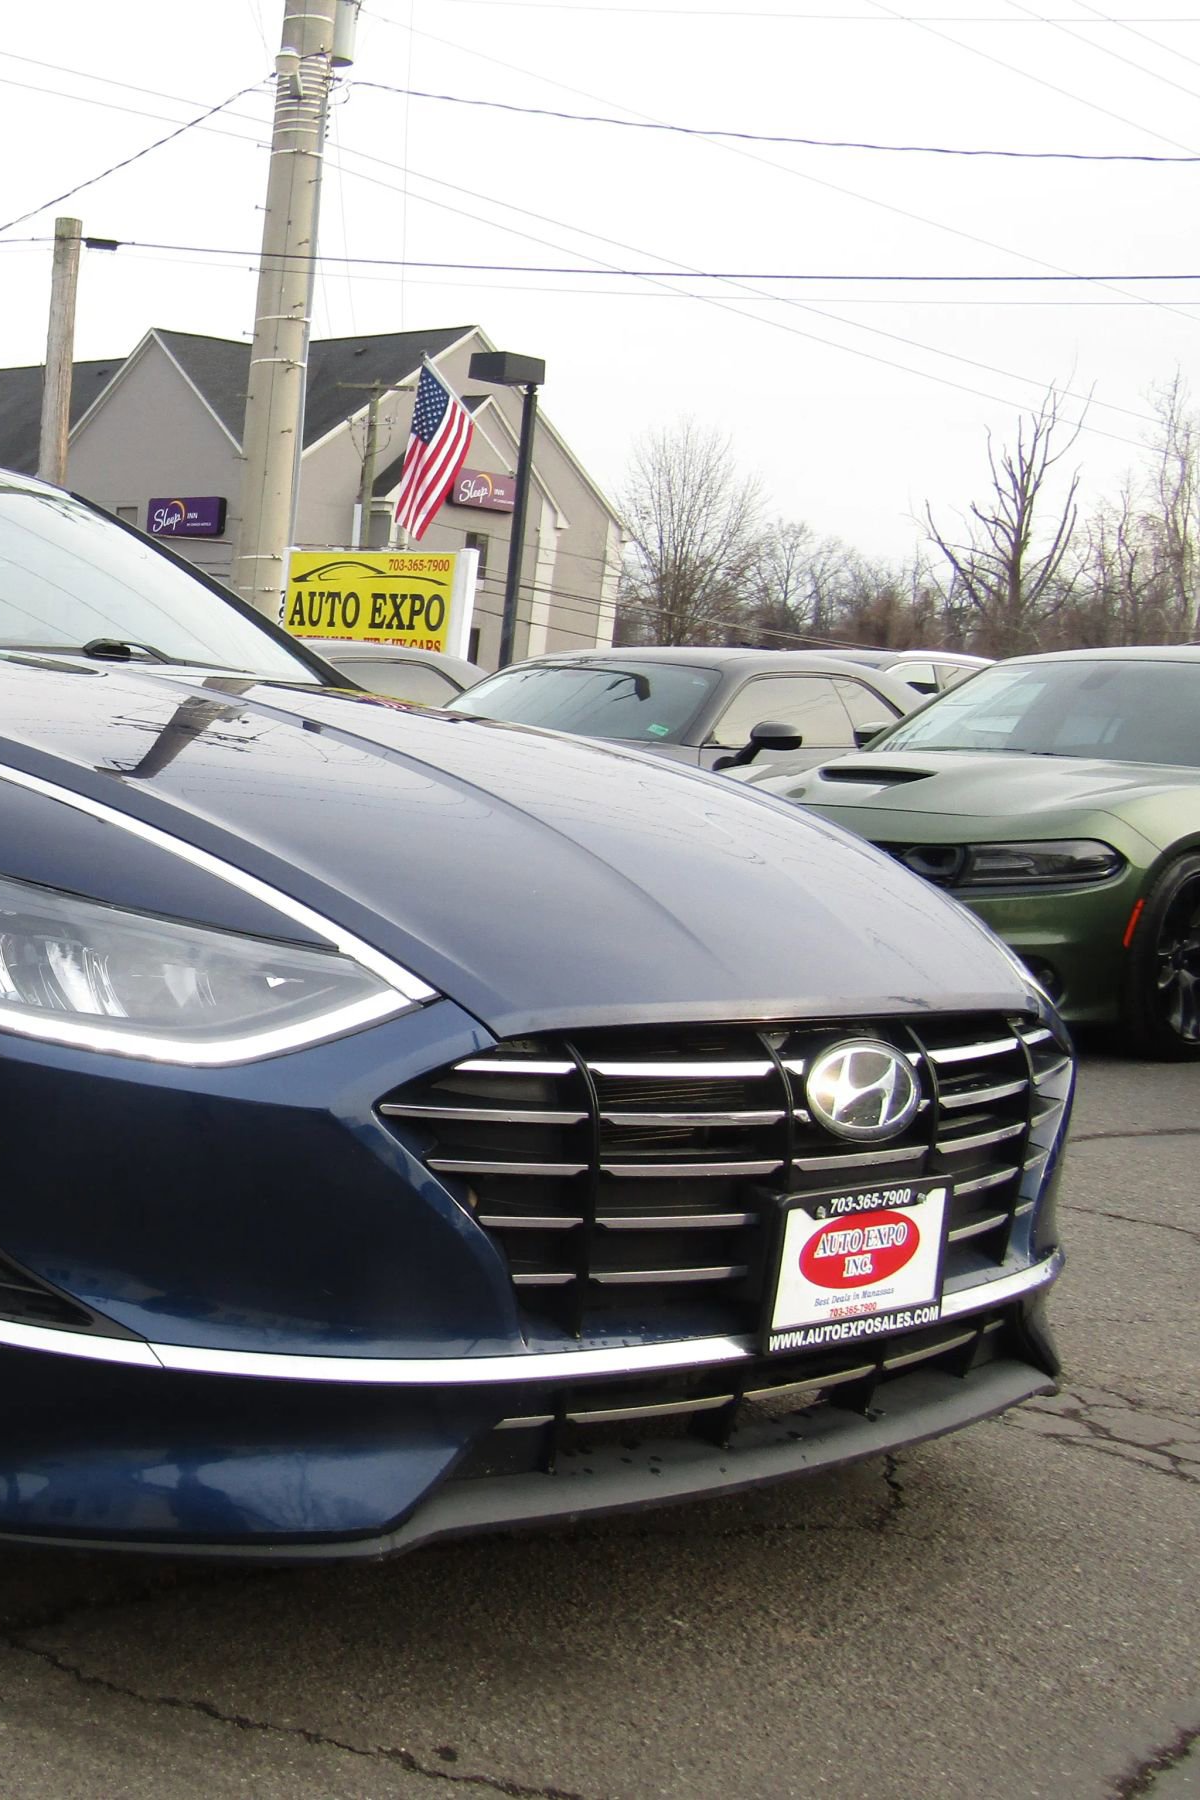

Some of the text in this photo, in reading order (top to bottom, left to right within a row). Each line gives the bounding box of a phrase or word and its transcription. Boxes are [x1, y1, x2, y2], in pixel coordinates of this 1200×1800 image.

[459, 480, 488, 504] Sleep
[152, 508, 199, 532] Sleep INN
[388, 559, 450, 572] 703-365-7900
[288, 591, 445, 632] AUTO EXPO
[830, 1188, 911, 1214] 703-365-7900
[814, 1223, 908, 1258] AUTO EXPO
[843, 1254, 873, 1277] INC.
[814, 1297, 830, 1307] Best
[831, 1294, 851, 1304] Deals
[861, 1287, 895, 1299] Manassas
[829, 1301, 877, 1318] 703-365-7900
[768, 1305, 939, 1352] WWW.AUTOEXPOSALES.COM
